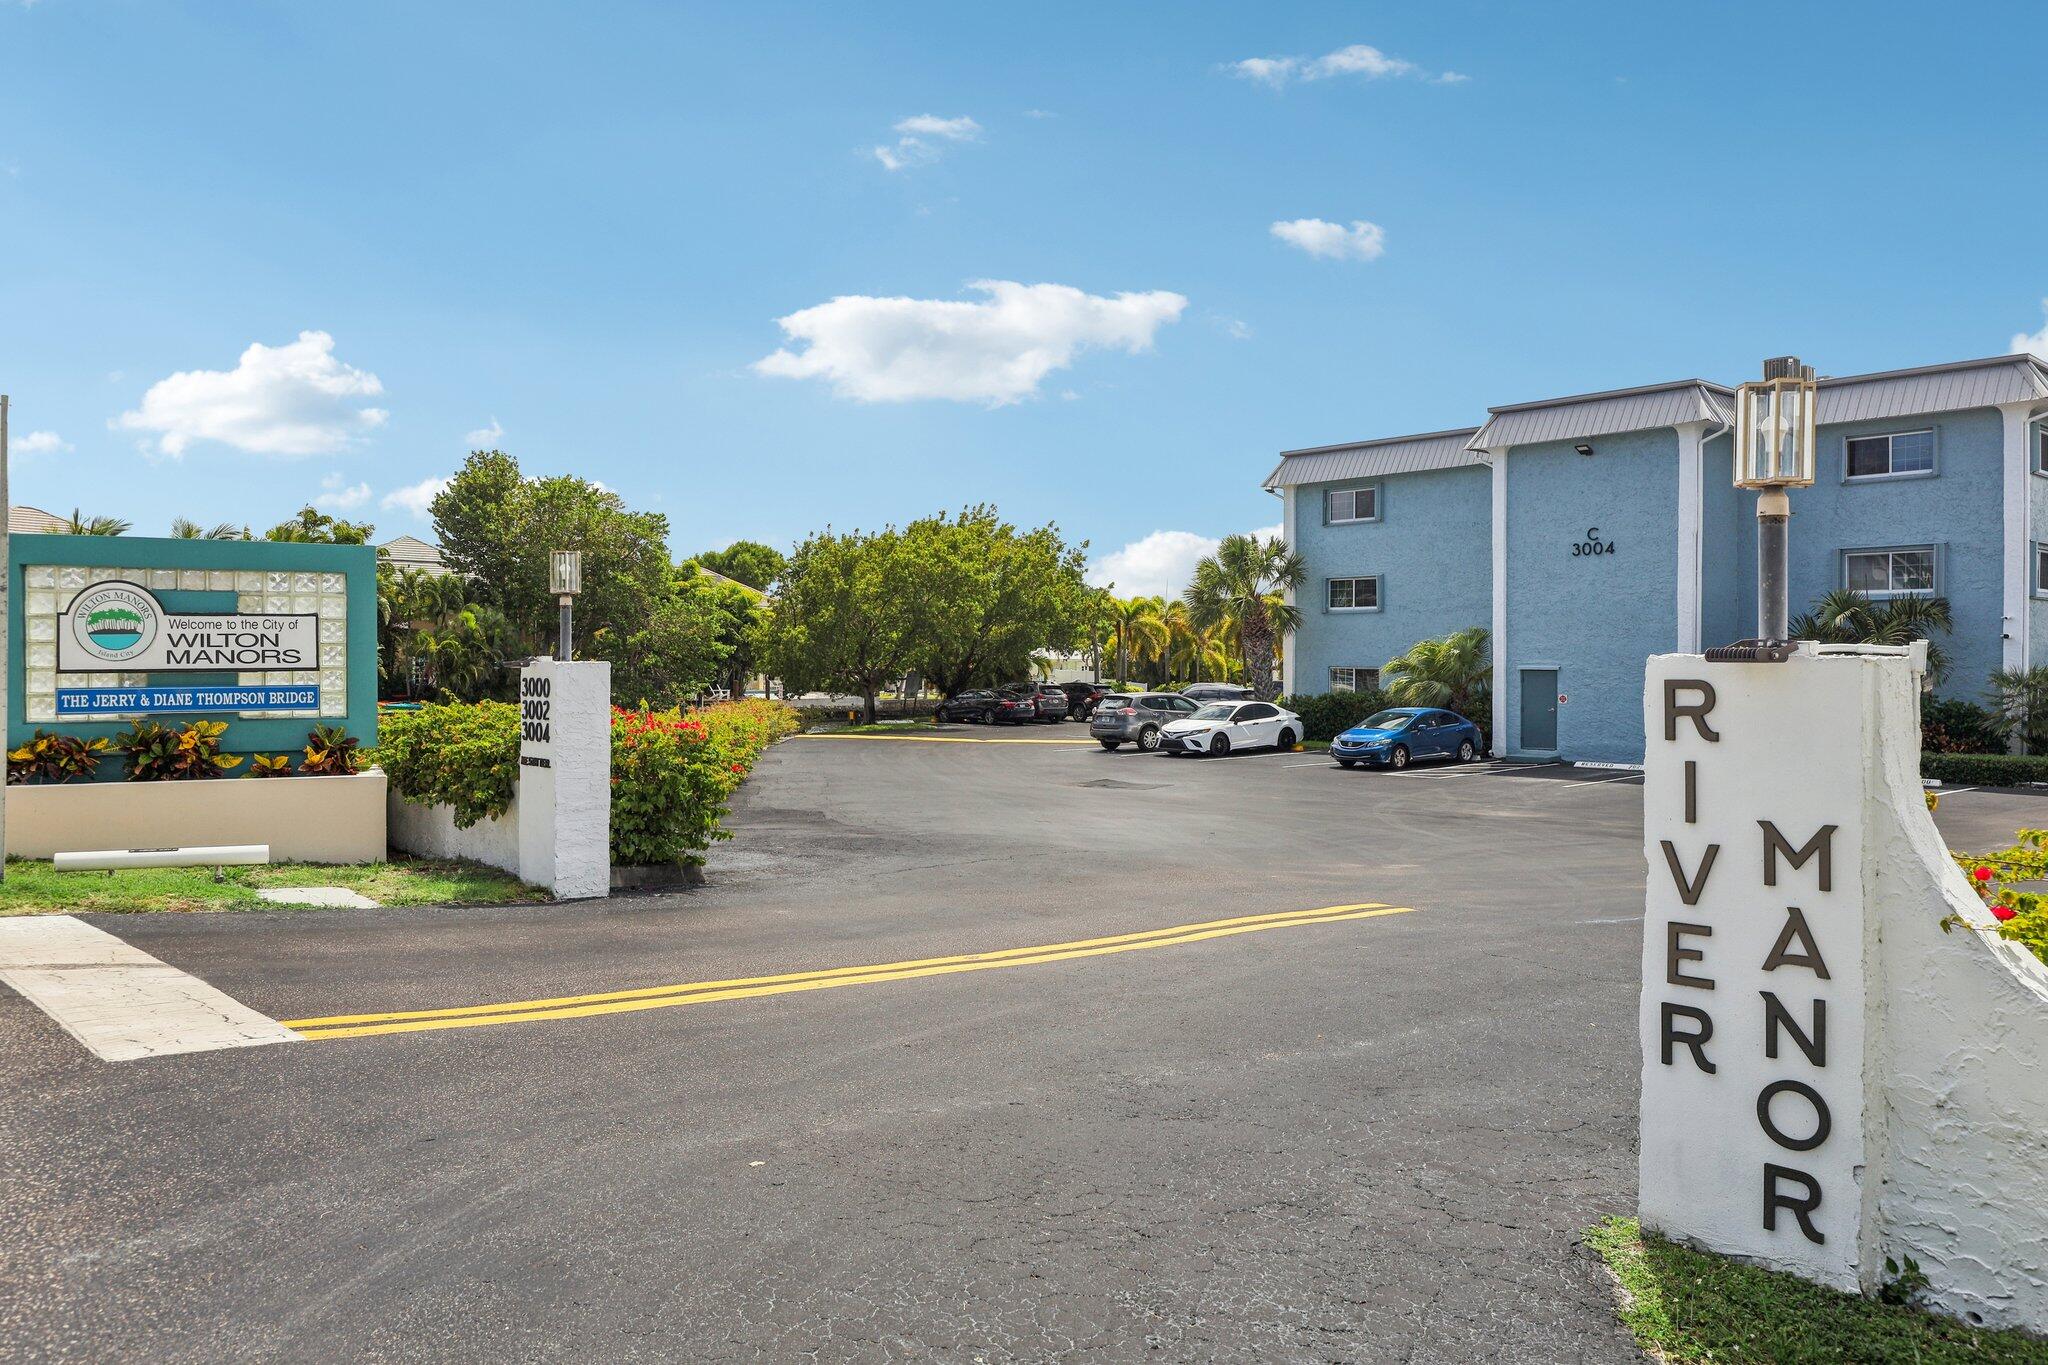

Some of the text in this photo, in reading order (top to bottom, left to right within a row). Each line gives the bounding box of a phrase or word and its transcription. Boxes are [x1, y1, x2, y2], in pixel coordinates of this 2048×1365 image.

[1587, 527, 1599, 541] C
[1572, 541, 1615, 557] 3004
[77, 591, 153, 620] WILTON MANORS
[168, 619, 299, 632] Welcome to the City of
[167, 633, 280, 648] WILTON
[98, 649, 134, 659] Island City
[166, 649, 302, 664] MANORS
[522, 677, 550, 698] 3000
[61, 691, 315, 708] THE JERRY & DIANE THOMPSON BRIDGE
[522, 700, 550, 720] 3002
[522, 721, 550, 743] 3004
[1660, 679, 1720, 1074] RIVER
[1756, 820, 1839, 1245] MANOR
